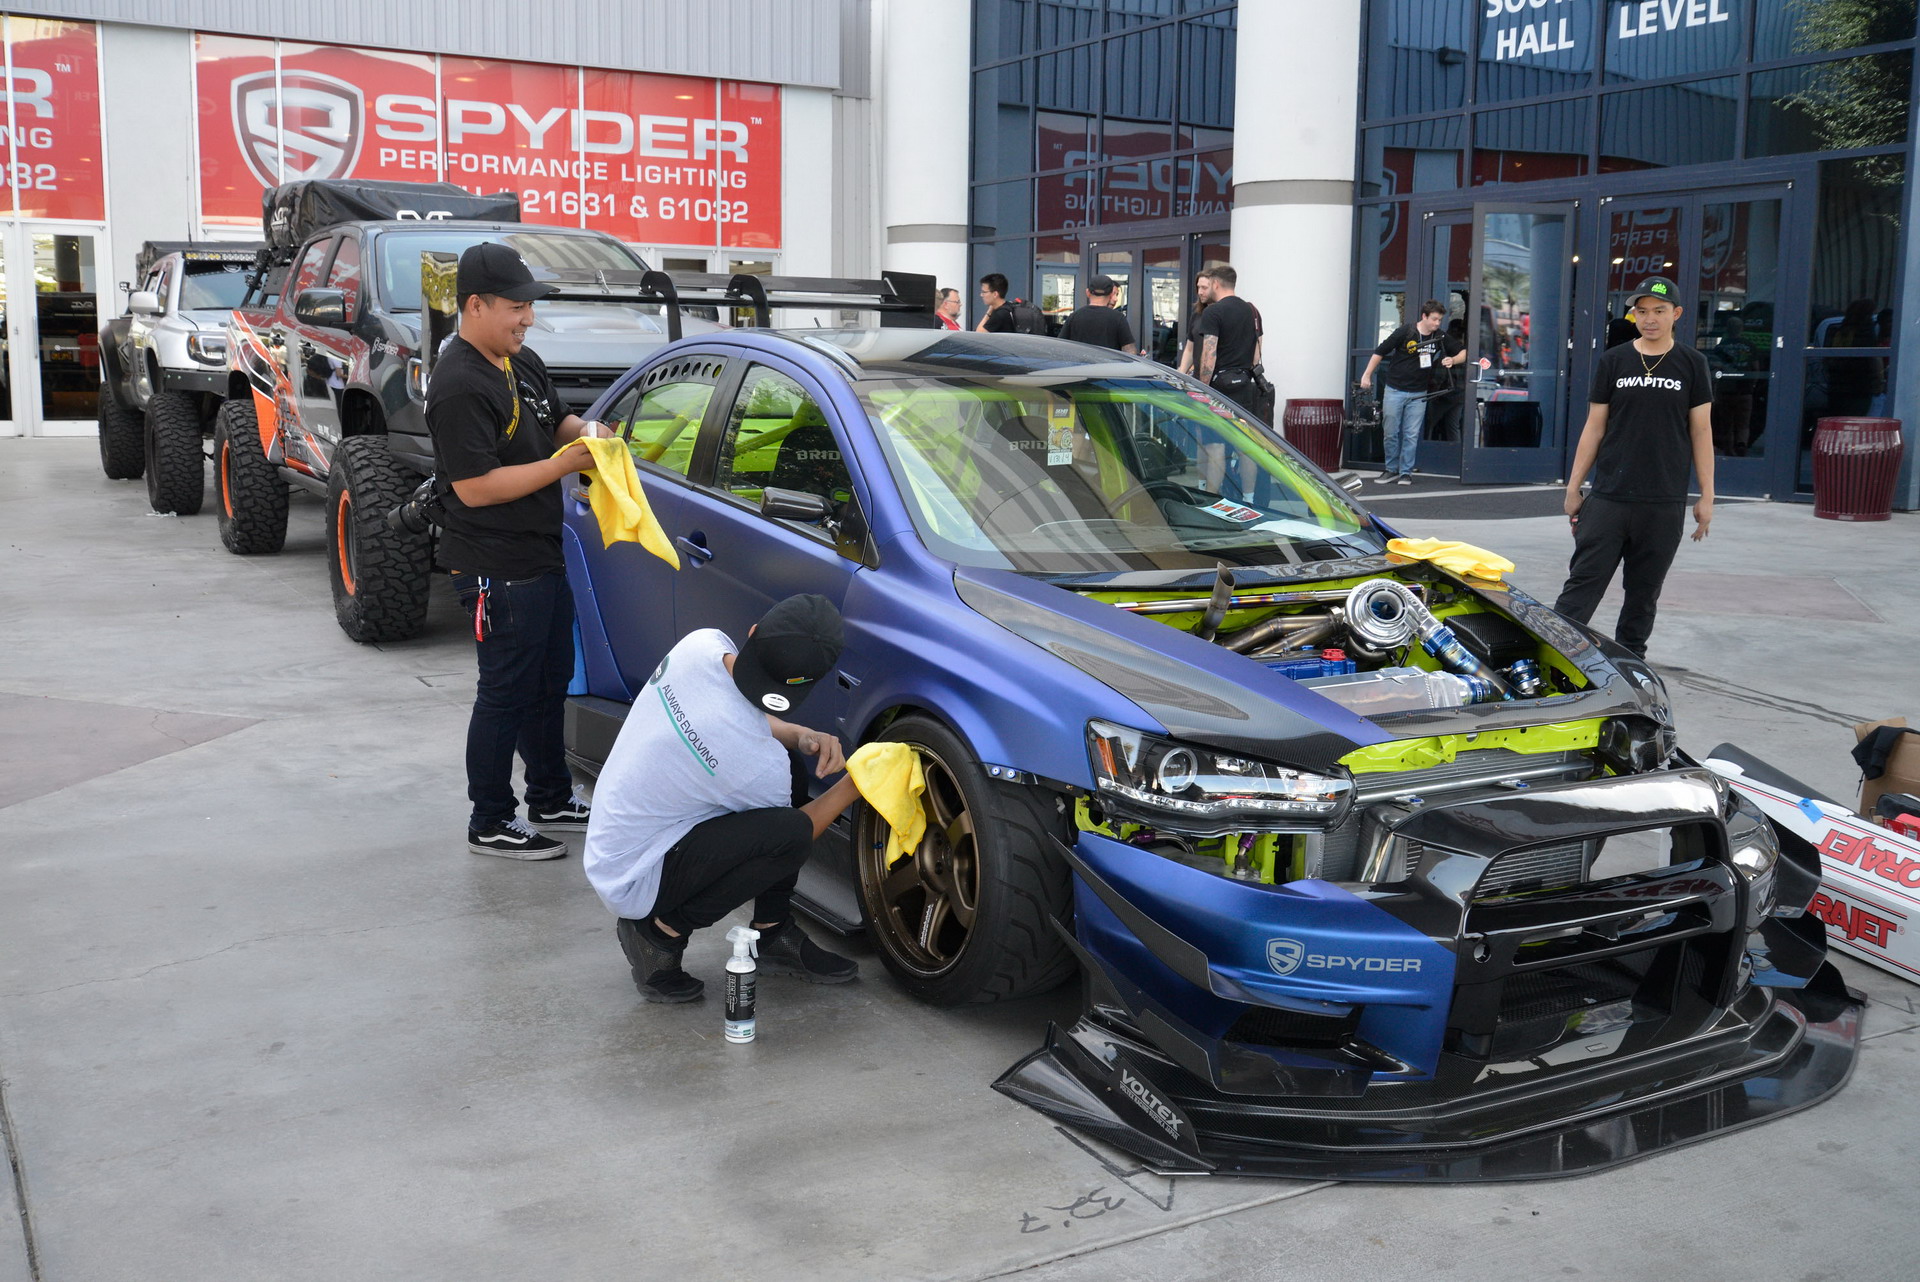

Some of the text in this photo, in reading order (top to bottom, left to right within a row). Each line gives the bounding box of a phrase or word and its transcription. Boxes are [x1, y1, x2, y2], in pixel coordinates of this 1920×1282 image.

[1496, 18, 1575, 60] HALL
[1619, 0, 1729, 39] LEVEL
[375, 94, 749, 163] SPYDER
[380, 148, 608, 181] PERFORMANCE
[621, 163, 748, 189] LIGHTING
[522, 189, 616, 217] 21631
[629, 196, 650, 219] &
[659, 195, 749, 224] 61032
[1616, 376, 1682, 391] GWAPITOS
[662, 684, 718, 769] ALWAYS EVOLVING
[1807, 892, 1898, 949] RAJET
[1306, 954, 1422, 973] SPYDER
[1122, 1068, 1184, 1132] VOLTEX
